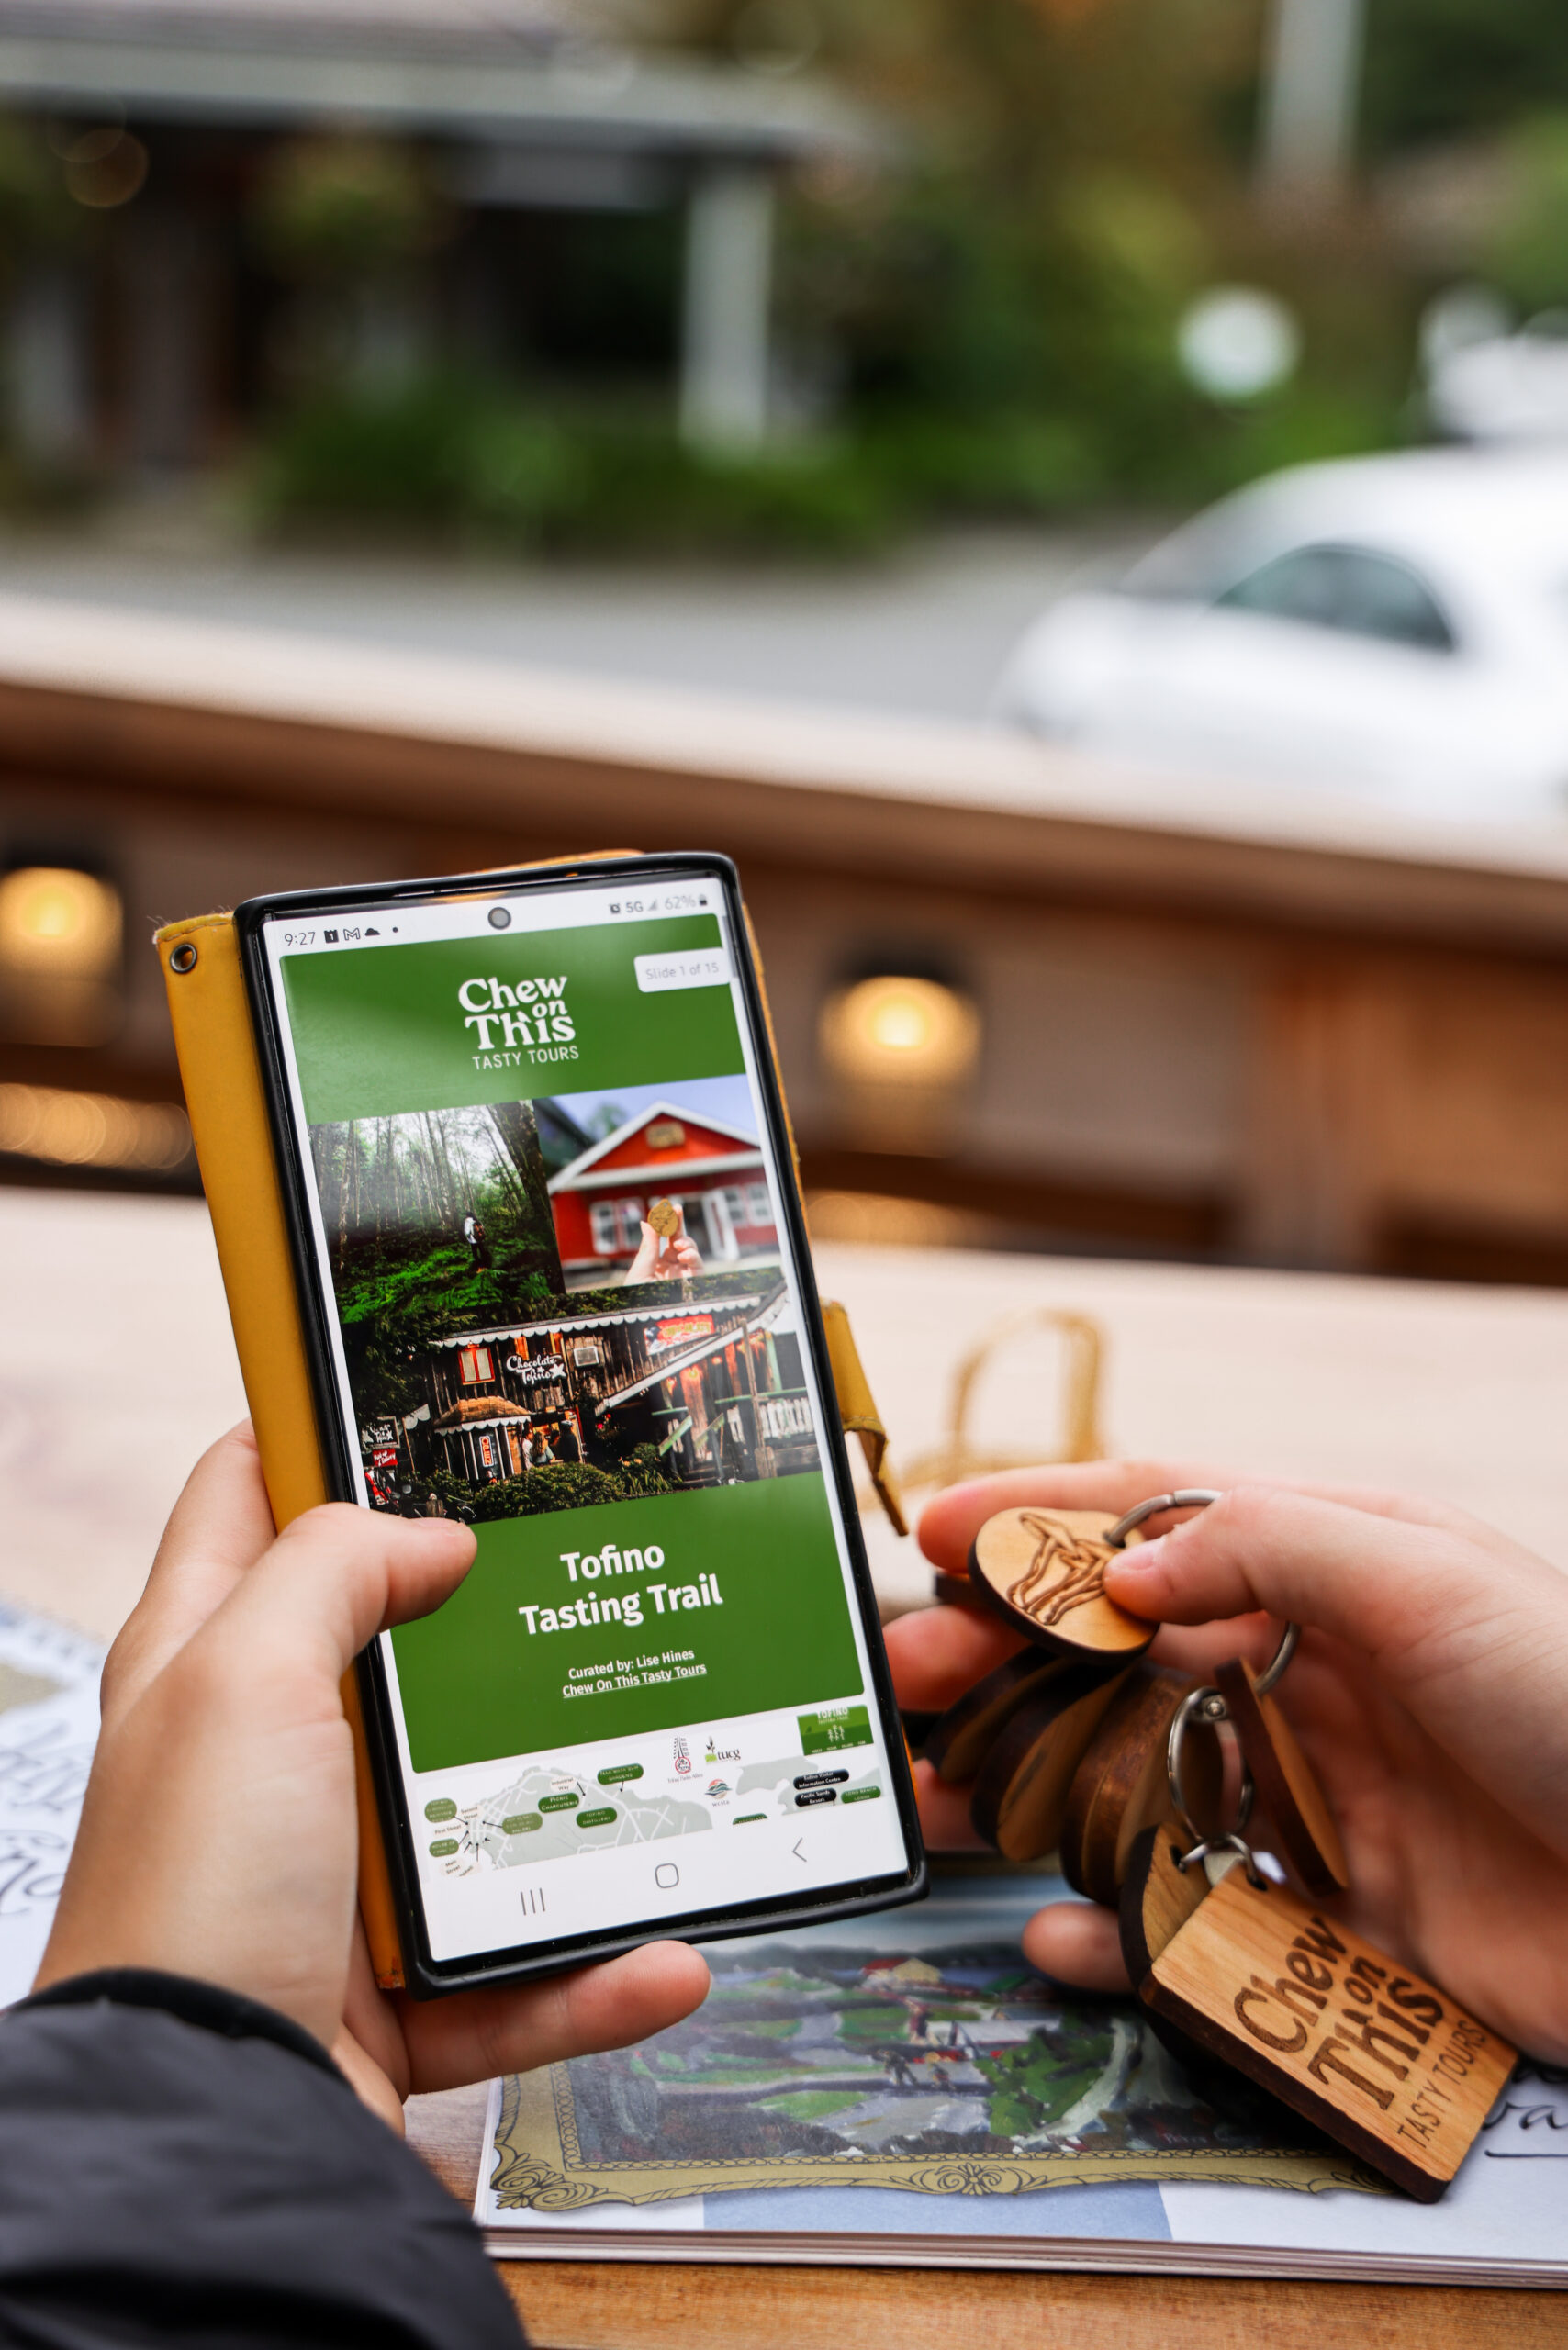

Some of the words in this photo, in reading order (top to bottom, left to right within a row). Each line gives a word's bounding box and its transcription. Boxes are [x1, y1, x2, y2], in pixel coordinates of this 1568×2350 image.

[625, 901, 644, 913] 5G
[664, 895, 697, 910] 62%
[284, 931, 317, 946] 9:27
[645, 967, 677, 980] Slide
[679, 965, 686, 976] 1
[689, 964, 700, 976] of
[705, 962, 720, 974] 15
[458, 976, 568, 1013] Chew
[532, 1000, 568, 1018] on
[465, 1010, 576, 1050] This
[472, 1051, 521, 1070] TASTY
[528, 1046, 579, 1064] TOURS
[506, 1353, 563, 1371] Chocolate
[515, 1367, 552, 1385] Tofino
[559, 1544, 665, 1582] Tofino
[518, 1591, 644, 1635] Tasting
[646, 1572, 723, 1614] Trail
[562, 1683, 594, 1697] Chew
[597, 1679, 613, 1692] On
[614, 1673, 641, 1688] This
[641, 1669, 672, 1683] Tasty
[674, 1663, 707, 1678] Tours
[568, 1661, 614, 1680] Curated
[616, 1660, 634, 1673] by:
[636, 1654, 659, 1668] Lise
[662, 1650, 695, 1664] Hines
[1234, 1916, 1347, 2053] Chew
[1342, 1955, 1387, 2005] on
[1306, 1977, 1444, 2110] This
[1396, 2078, 1452, 2149] TASTY
[1432, 2020, 1485, 2086] TOURS
